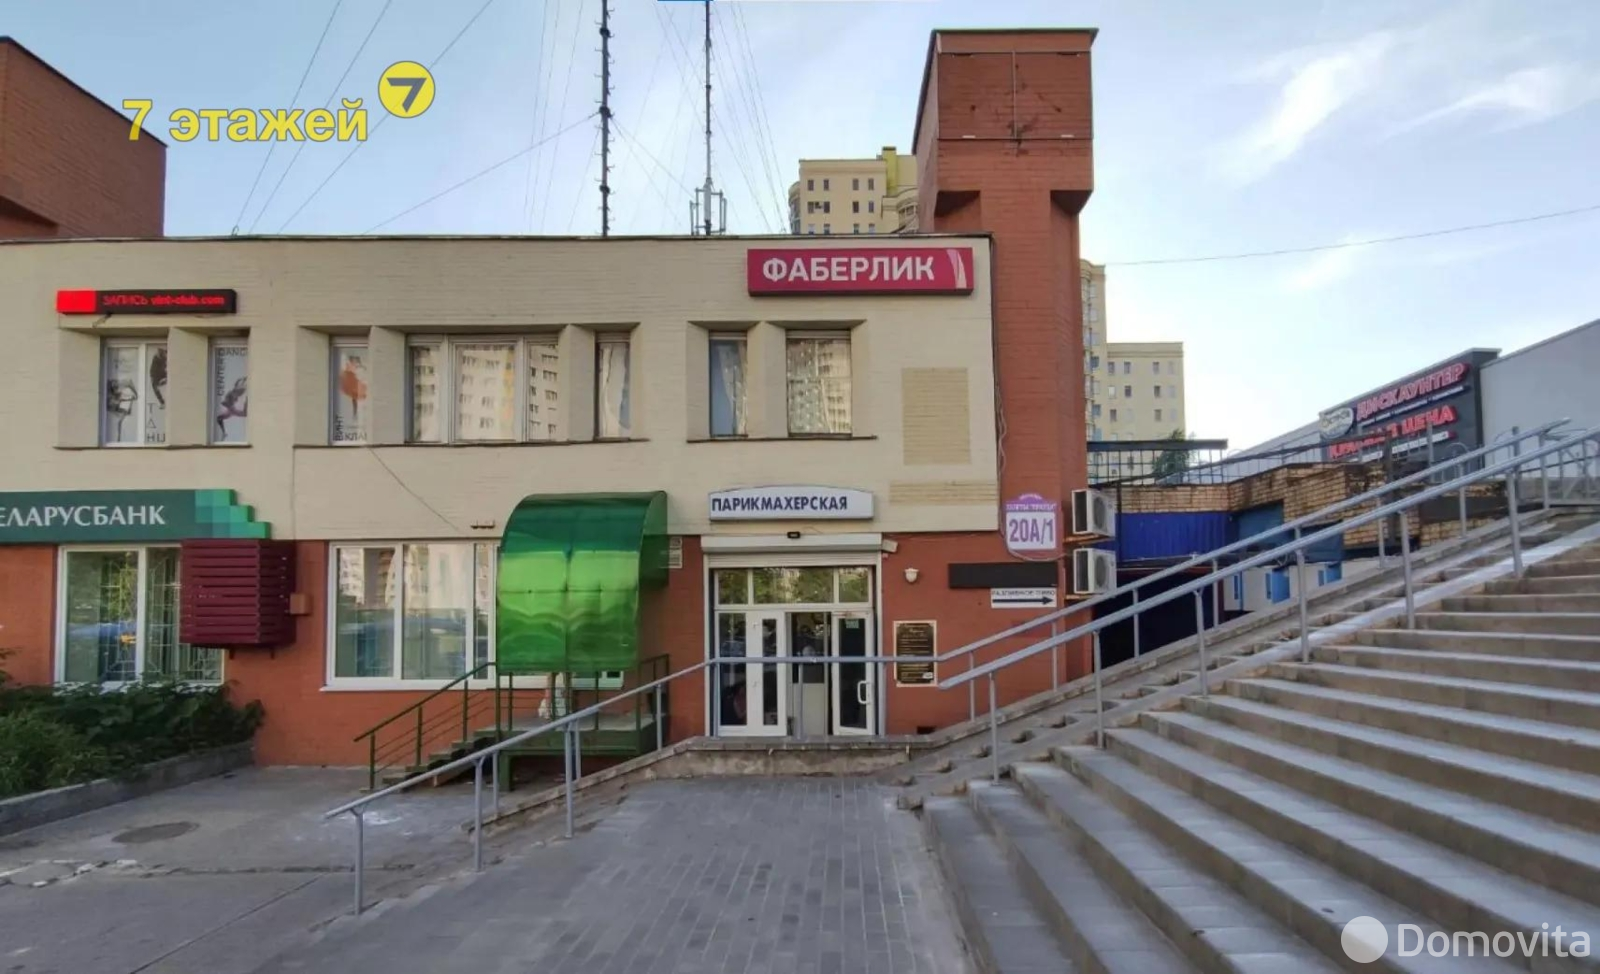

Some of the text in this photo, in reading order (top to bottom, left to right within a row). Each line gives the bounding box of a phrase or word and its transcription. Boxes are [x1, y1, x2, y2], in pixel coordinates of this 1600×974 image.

[762, 256, 935, 282] ФАБЕРЛИК
[1357, 363, 1466, 422] ДИСКАУНТЕР
[1402, 405, 1456, 434] ЦЕНА
[0, 505, 166, 527] ЕЛАРУСБАНК
[711, 496, 848, 511] ПАРИКМАХЕРСКАЯ
[1009, 518, 1054, 544] 20А/1
